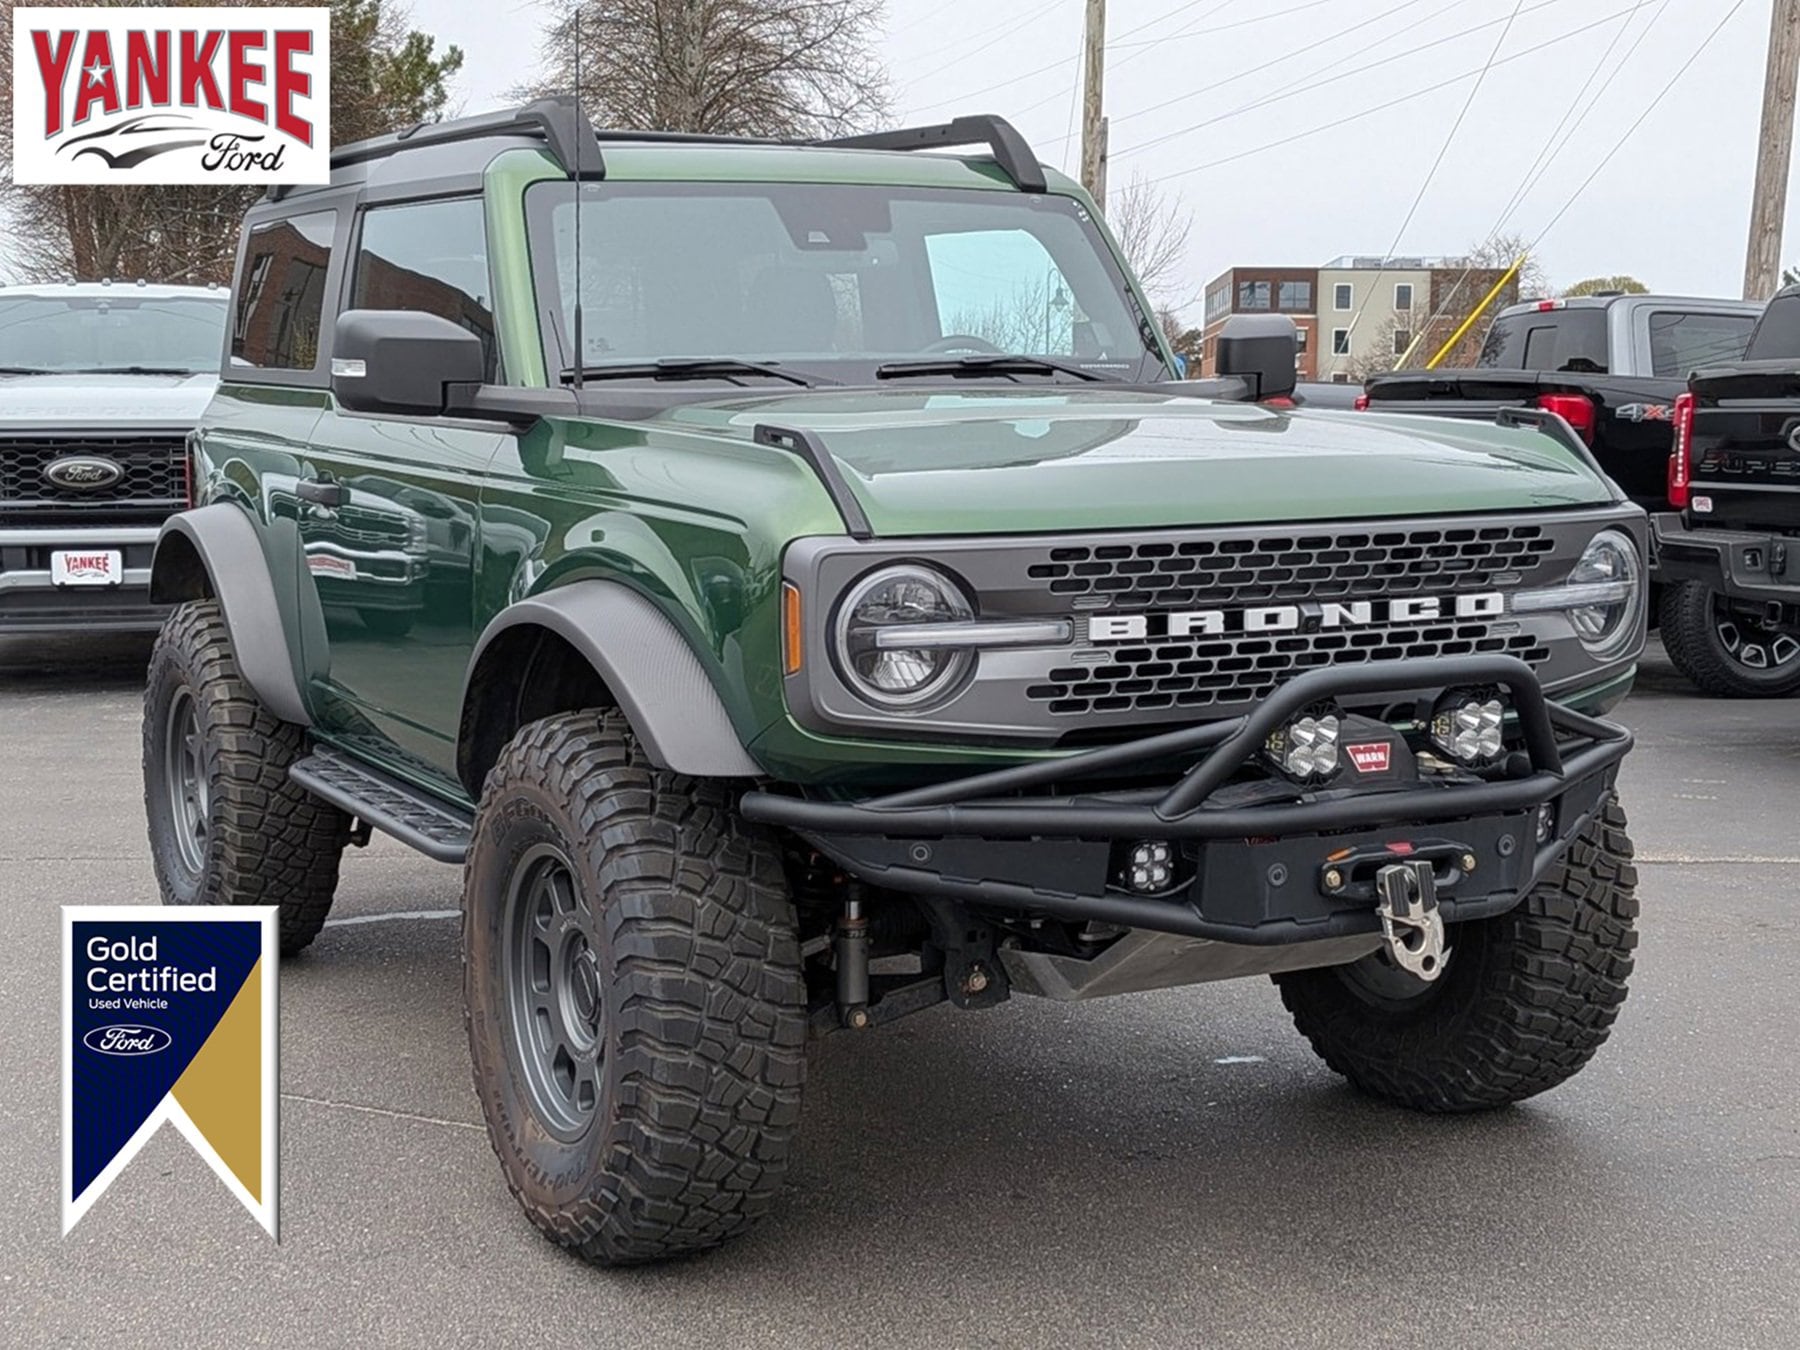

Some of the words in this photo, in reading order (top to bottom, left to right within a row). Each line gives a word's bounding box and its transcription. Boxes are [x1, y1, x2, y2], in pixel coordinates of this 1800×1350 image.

[64, 464, 102, 481] Ford
[1699, 460, 1800, 476] SUPE
[64, 553, 109, 573] YANKEE
[1088, 592, 1504, 641] BRONCO
[1355, 751, 1386, 764] WARN
